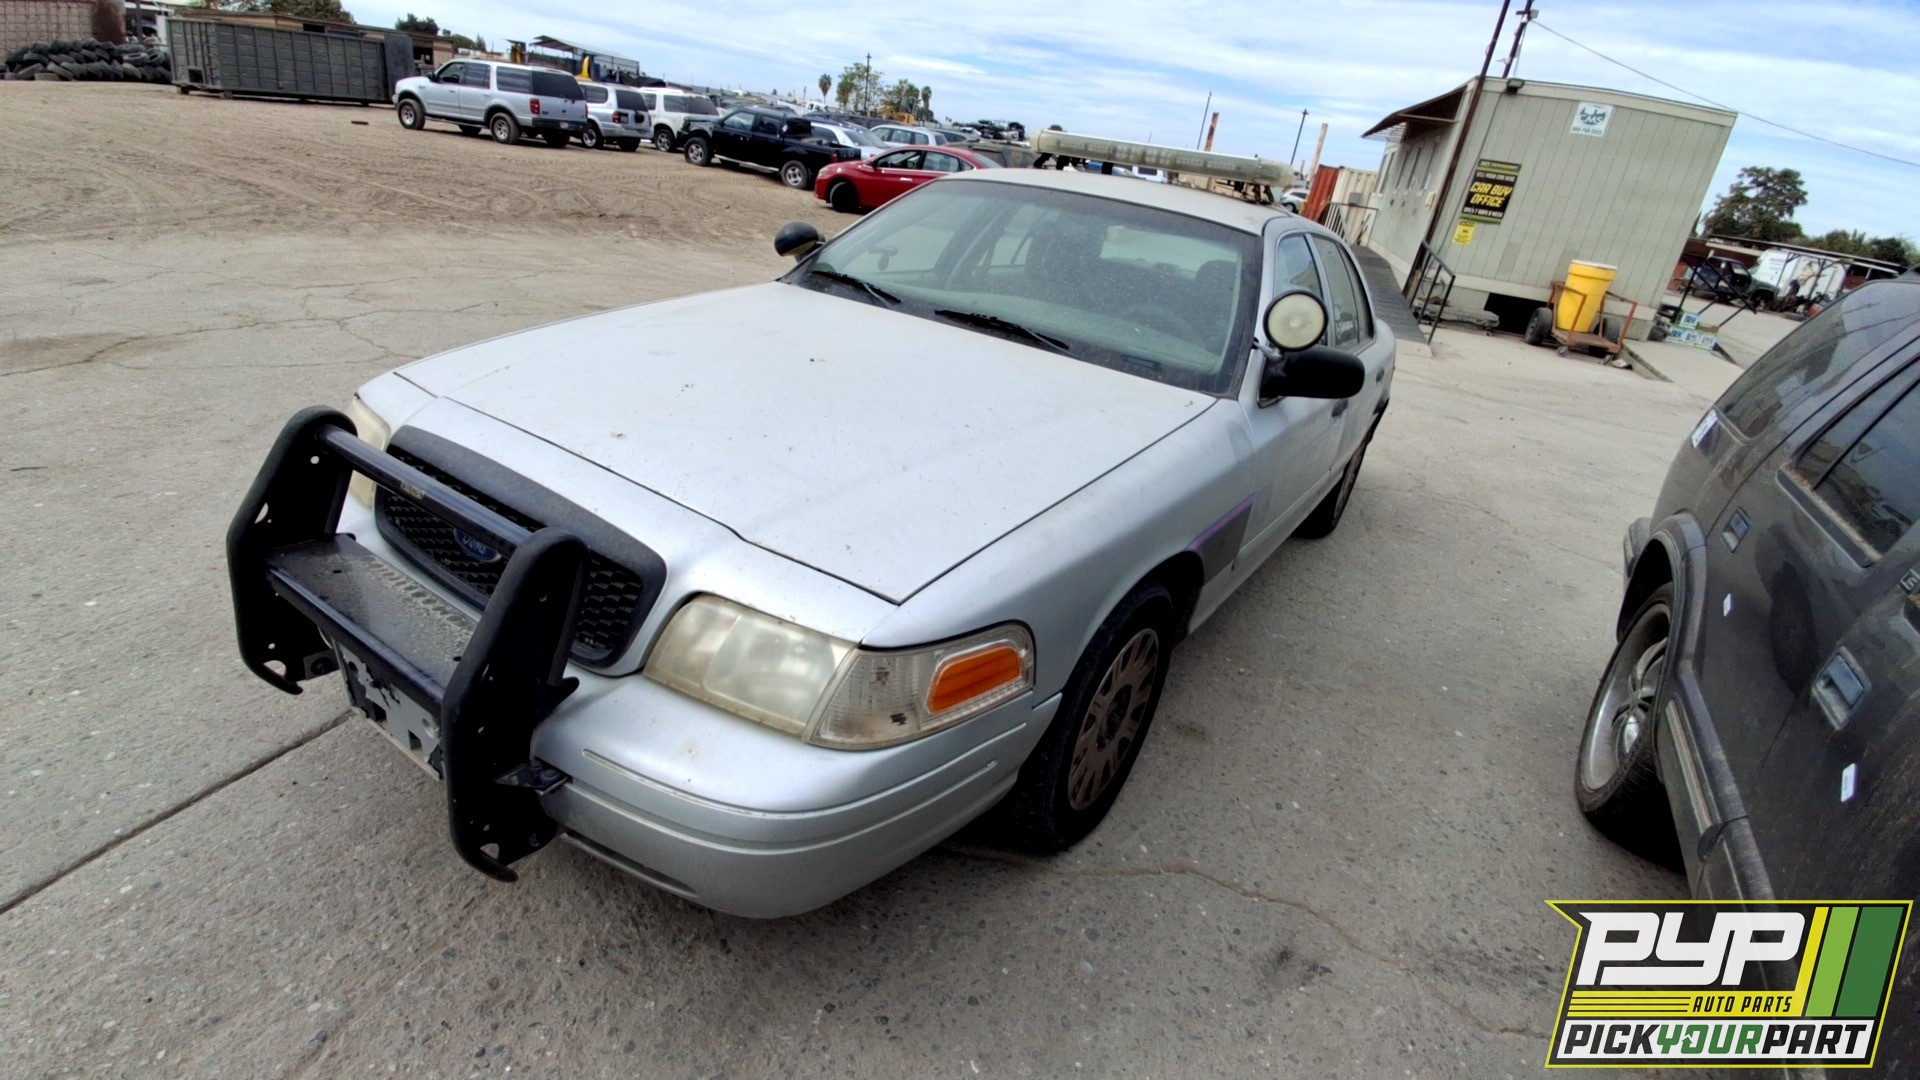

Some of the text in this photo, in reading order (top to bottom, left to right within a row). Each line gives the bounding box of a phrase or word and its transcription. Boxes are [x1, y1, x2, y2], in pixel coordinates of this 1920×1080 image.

[1470, 182, 1512, 197] CAR BUY
[1470, 194, 1504, 207] OFFICE
